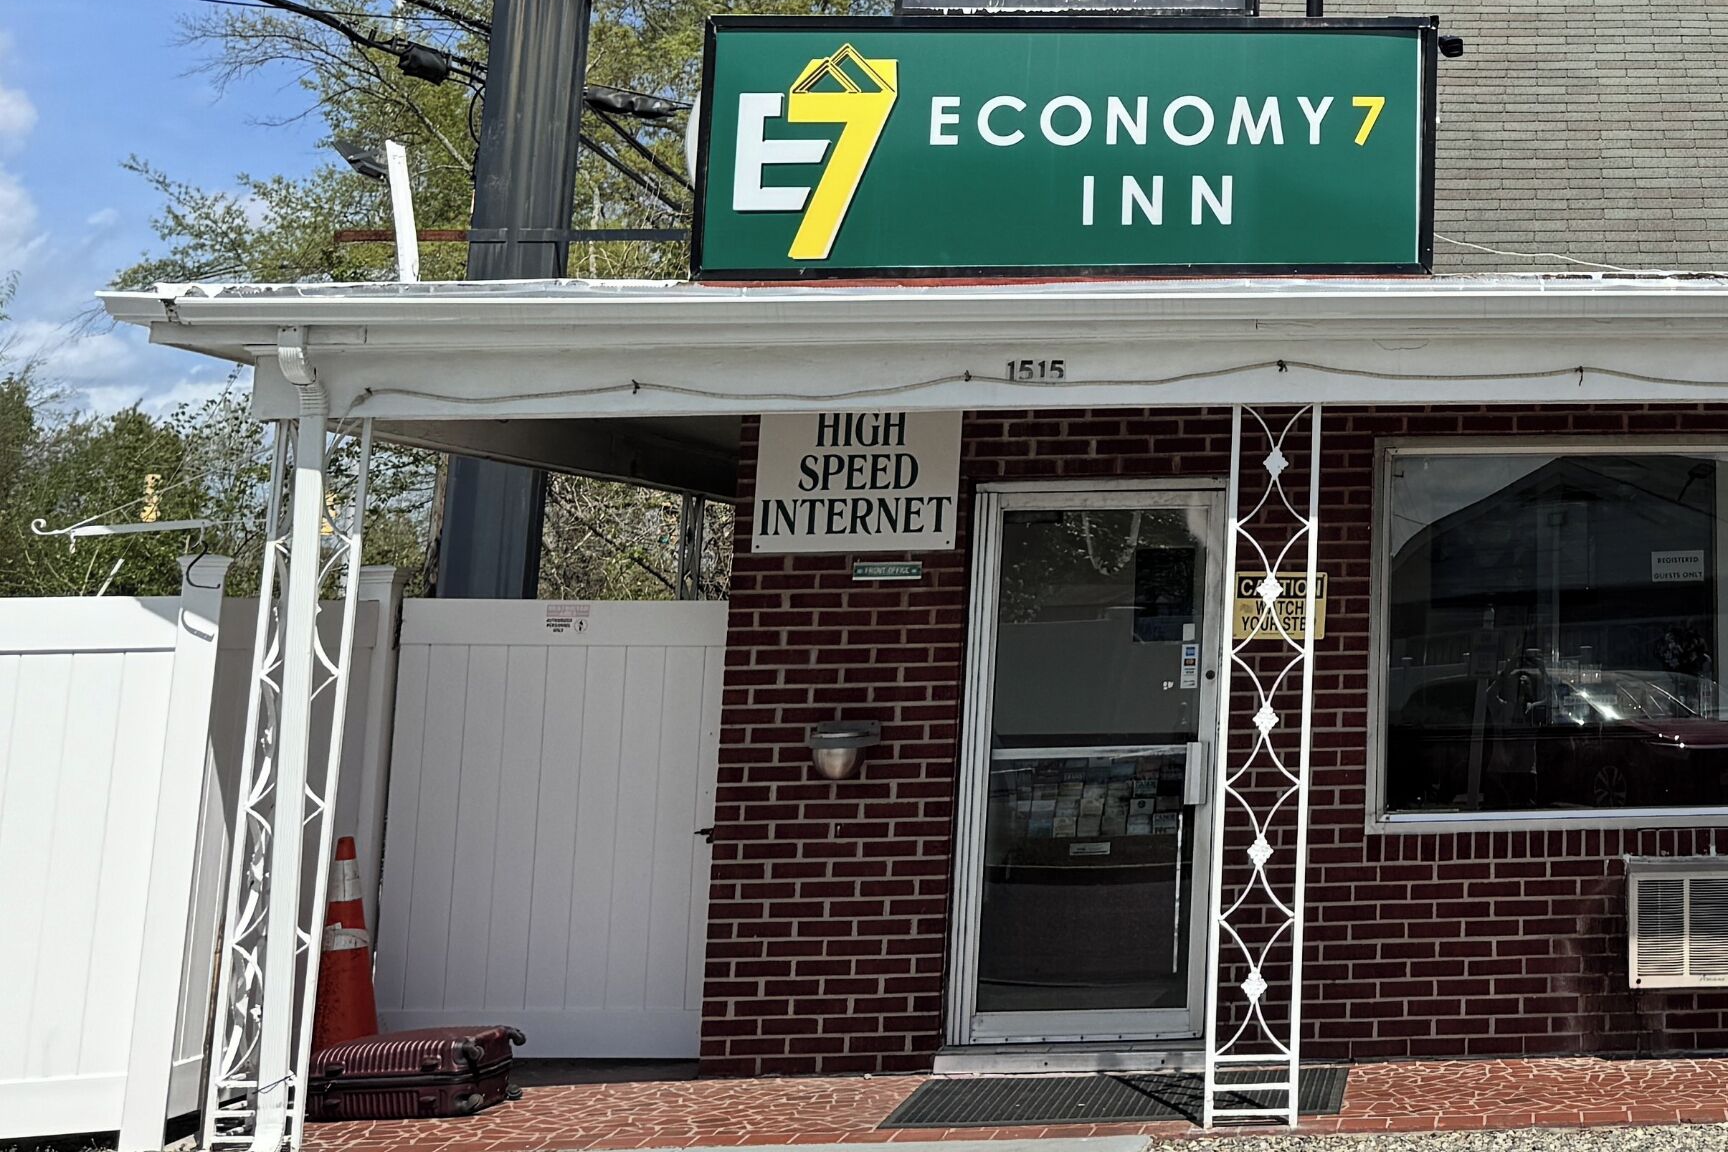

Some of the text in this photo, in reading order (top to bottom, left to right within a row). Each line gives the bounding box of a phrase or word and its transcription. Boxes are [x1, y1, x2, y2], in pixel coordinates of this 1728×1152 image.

[929, 94, 1387, 147] ECONOMY 7
[1082, 174, 1234, 227] INN
[1006, 359, 1066, 382] 1515
[815, 411, 907, 448] HIGH
[797, 452, 919, 492] SPEED
[759, 496, 952, 536] INTERNET
[1282, 615, 1316, 632] STE
